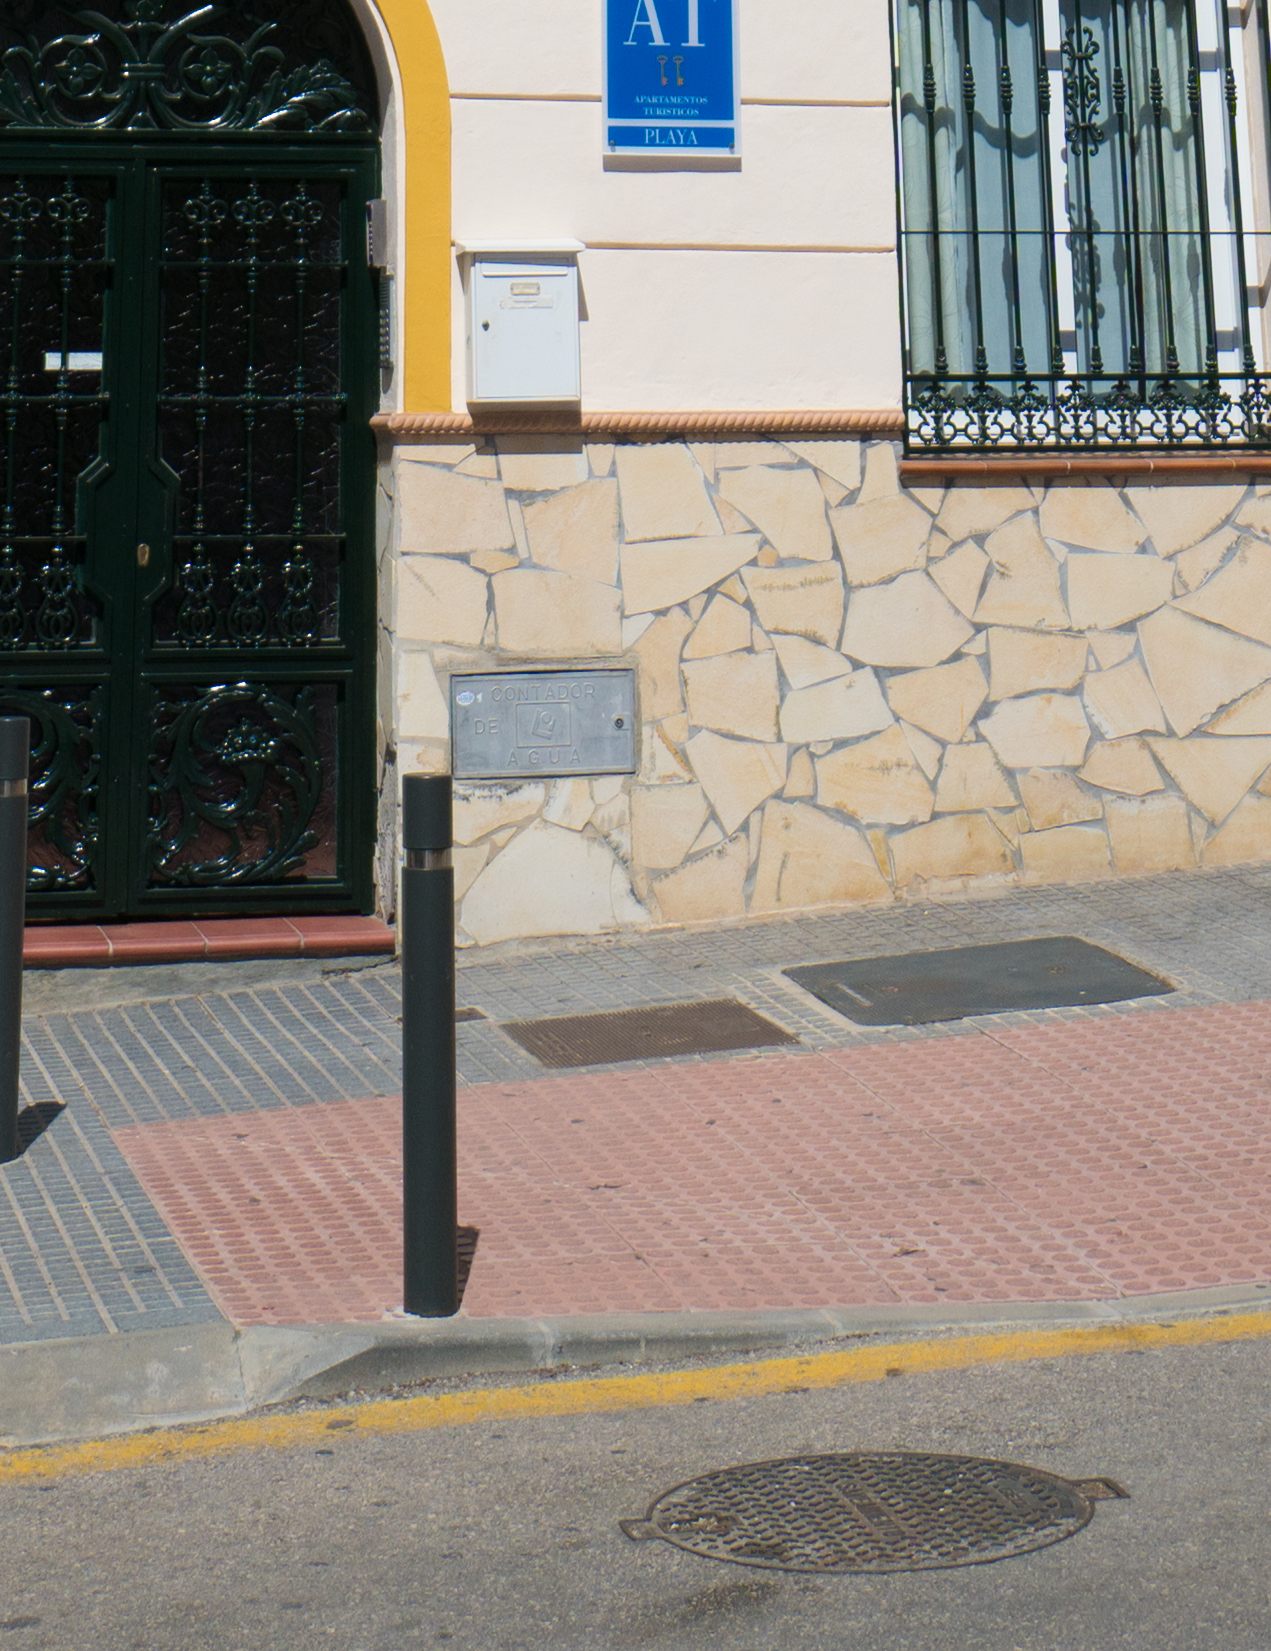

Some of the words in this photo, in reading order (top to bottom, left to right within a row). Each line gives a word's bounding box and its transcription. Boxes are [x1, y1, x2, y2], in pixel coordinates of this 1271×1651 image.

[634, 94, 708, 104] APARTAMENTOS
[644, 128, 699, 145] PLAYA
[491, 682, 596, 702] CONTADOR
[474, 718, 499, 734] DE
[507, 749, 581, 766] AGUA
